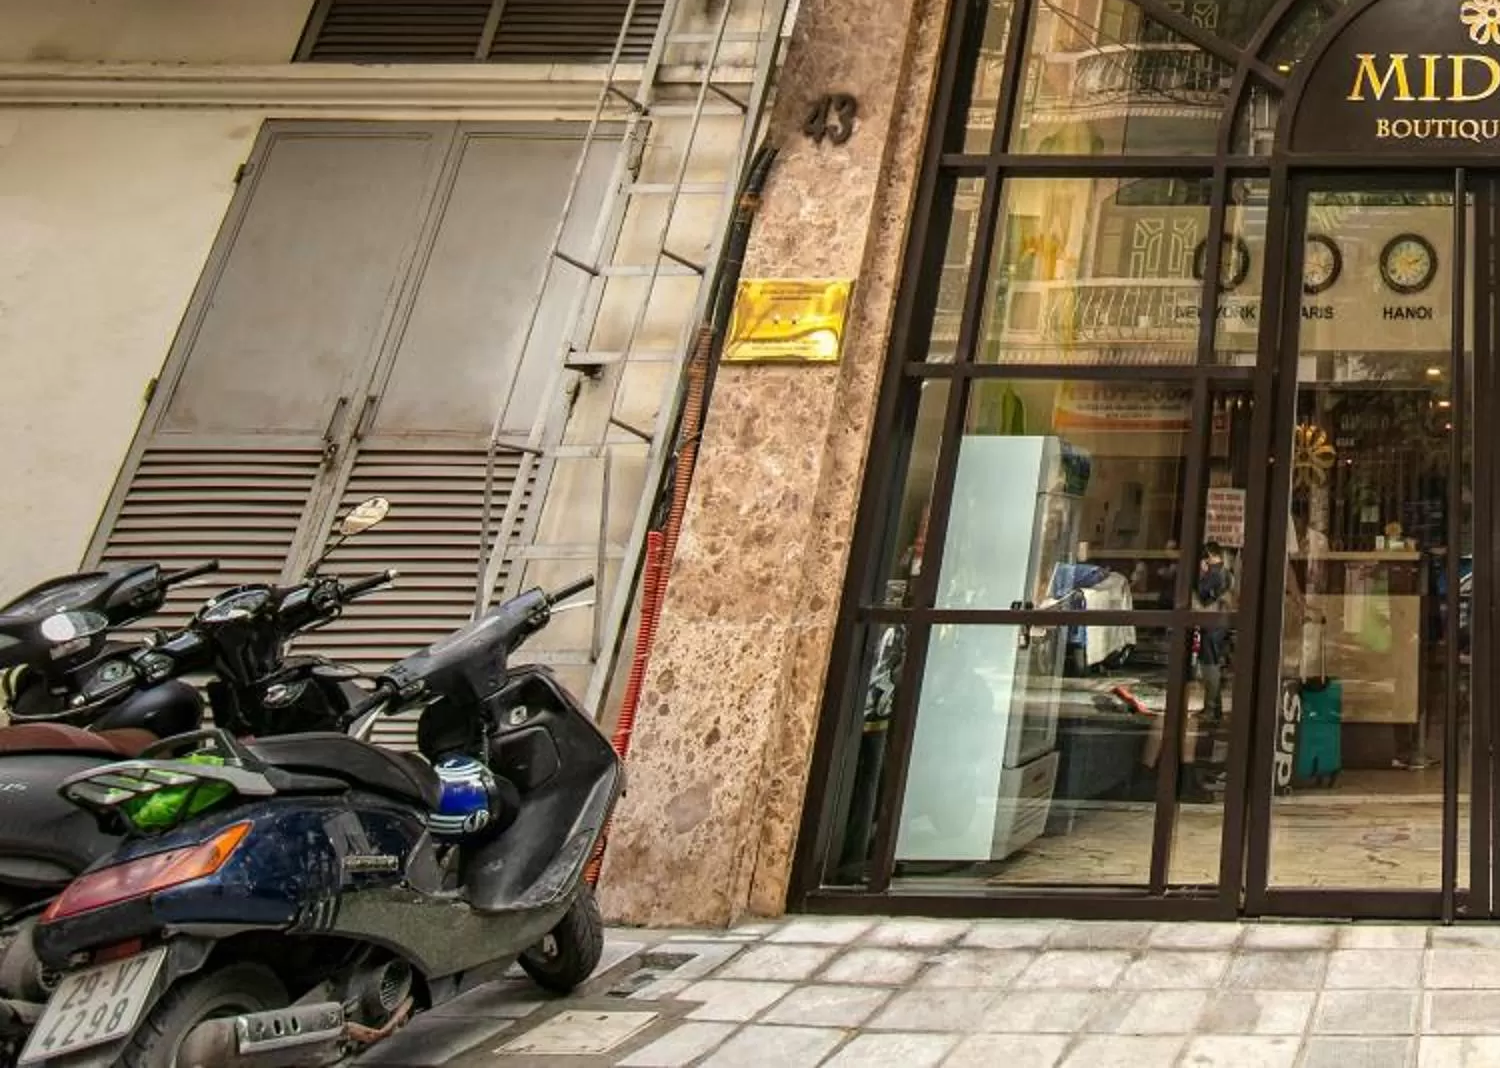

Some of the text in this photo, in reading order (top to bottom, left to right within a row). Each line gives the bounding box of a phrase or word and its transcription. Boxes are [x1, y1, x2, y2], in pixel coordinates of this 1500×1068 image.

[804, 92, 858, 146] 43
[1300, 306, 1334, 320] ARIS
[1382, 306, 1433, 321] HANOI
[40, 997, 130, 1050] 4298
